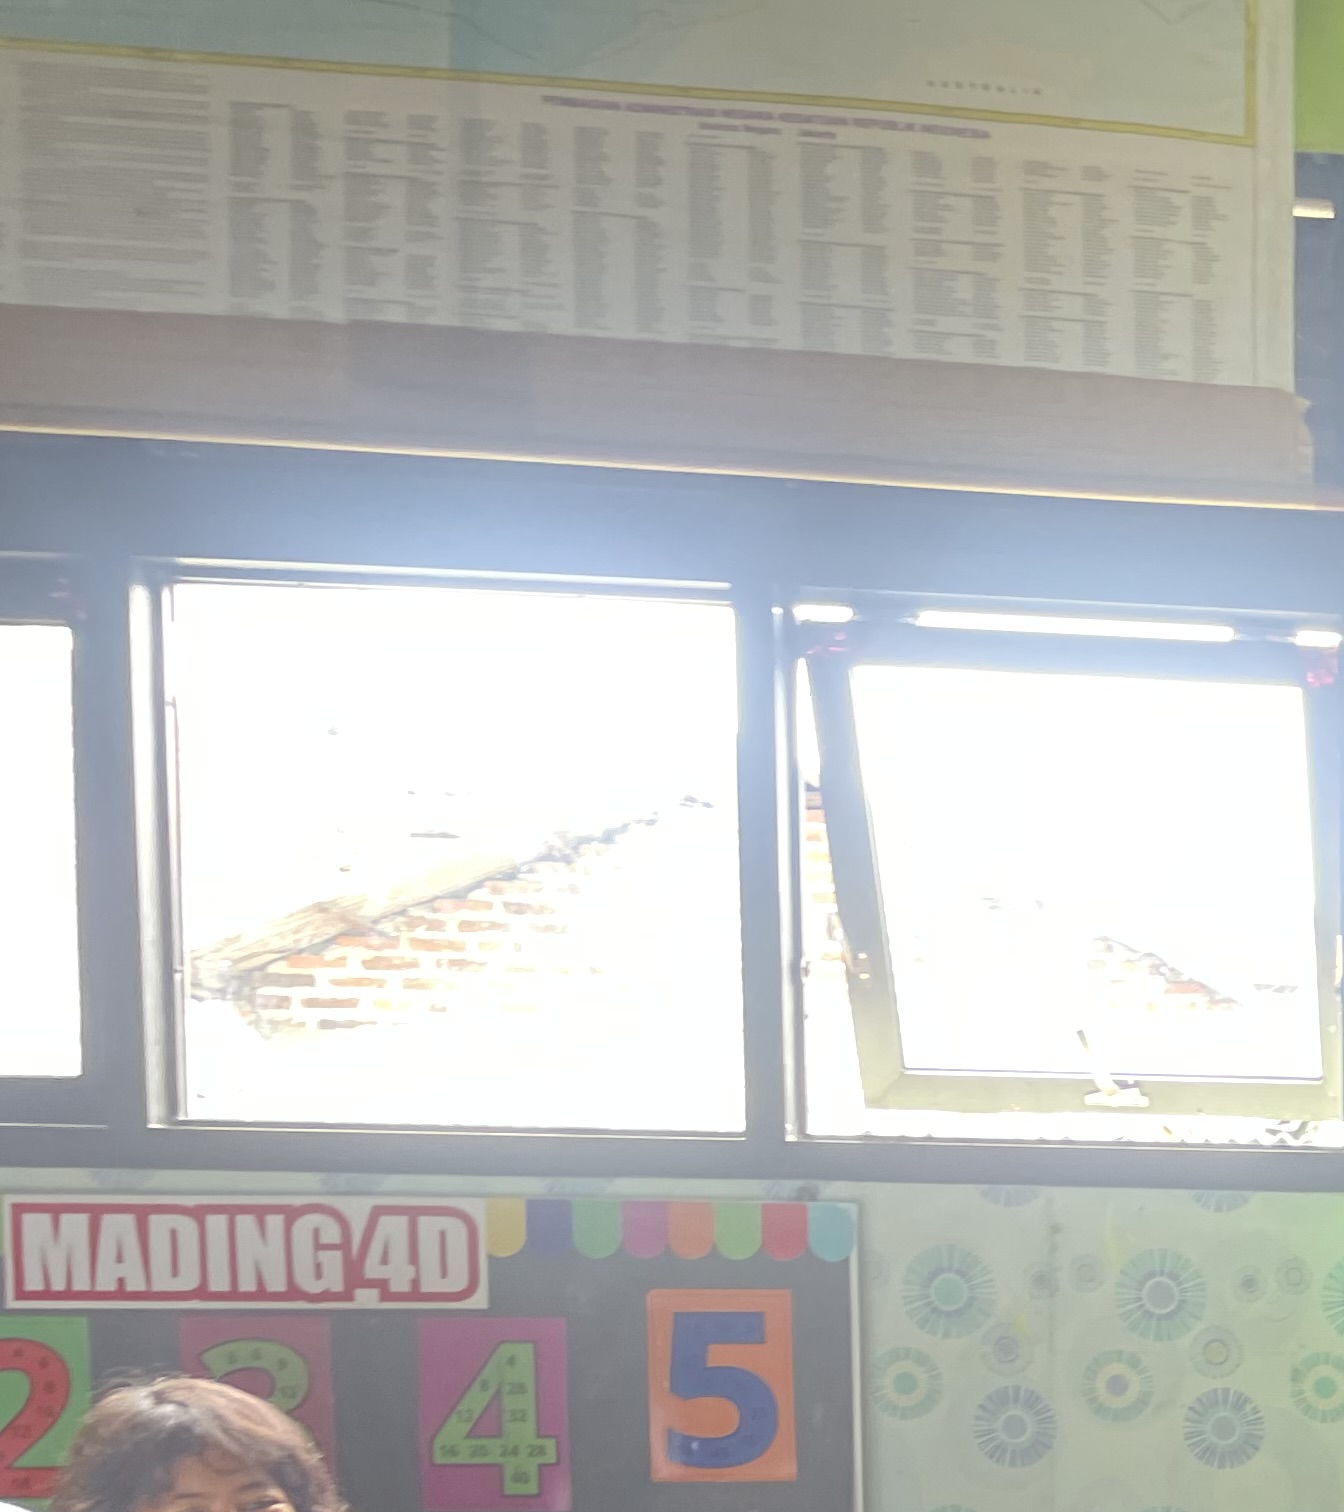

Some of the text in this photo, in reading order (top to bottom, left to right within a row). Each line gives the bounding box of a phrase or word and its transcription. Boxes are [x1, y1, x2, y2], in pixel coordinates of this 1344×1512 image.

[21, 1212, 472, 1294] MADING 4D
[431, 1339, 560, 1498] 4
[667, 1311, 779, 1470] 5
